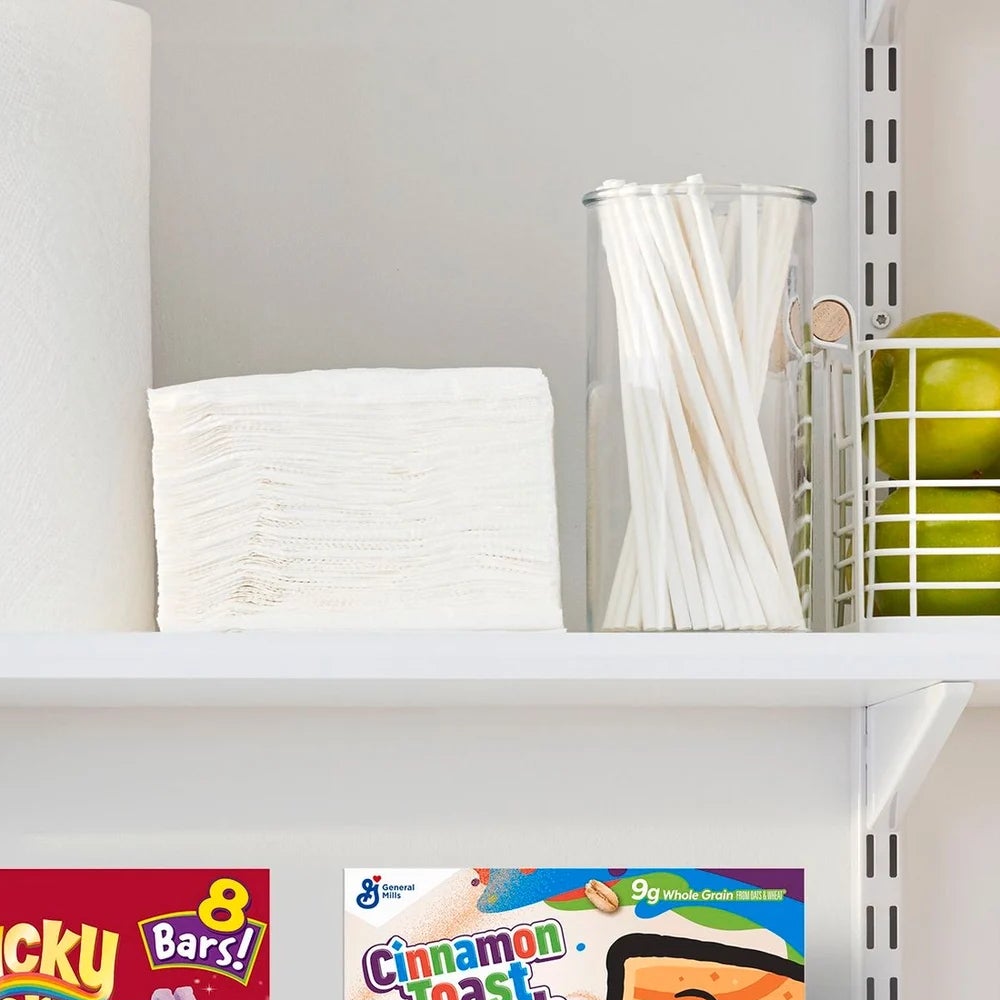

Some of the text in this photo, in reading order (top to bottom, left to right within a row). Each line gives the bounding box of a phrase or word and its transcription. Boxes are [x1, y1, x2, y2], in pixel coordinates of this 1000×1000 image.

[198, 878, 249, 932] 8
[382, 883, 415, 891] General
[631, 878, 660, 905] 9g
[663, 889, 699, 901] Whole
[701, 889, 733, 901] Grain
[152, 922, 254, 971] Bars!
[370, 923, 562, 985] Cinnamon
